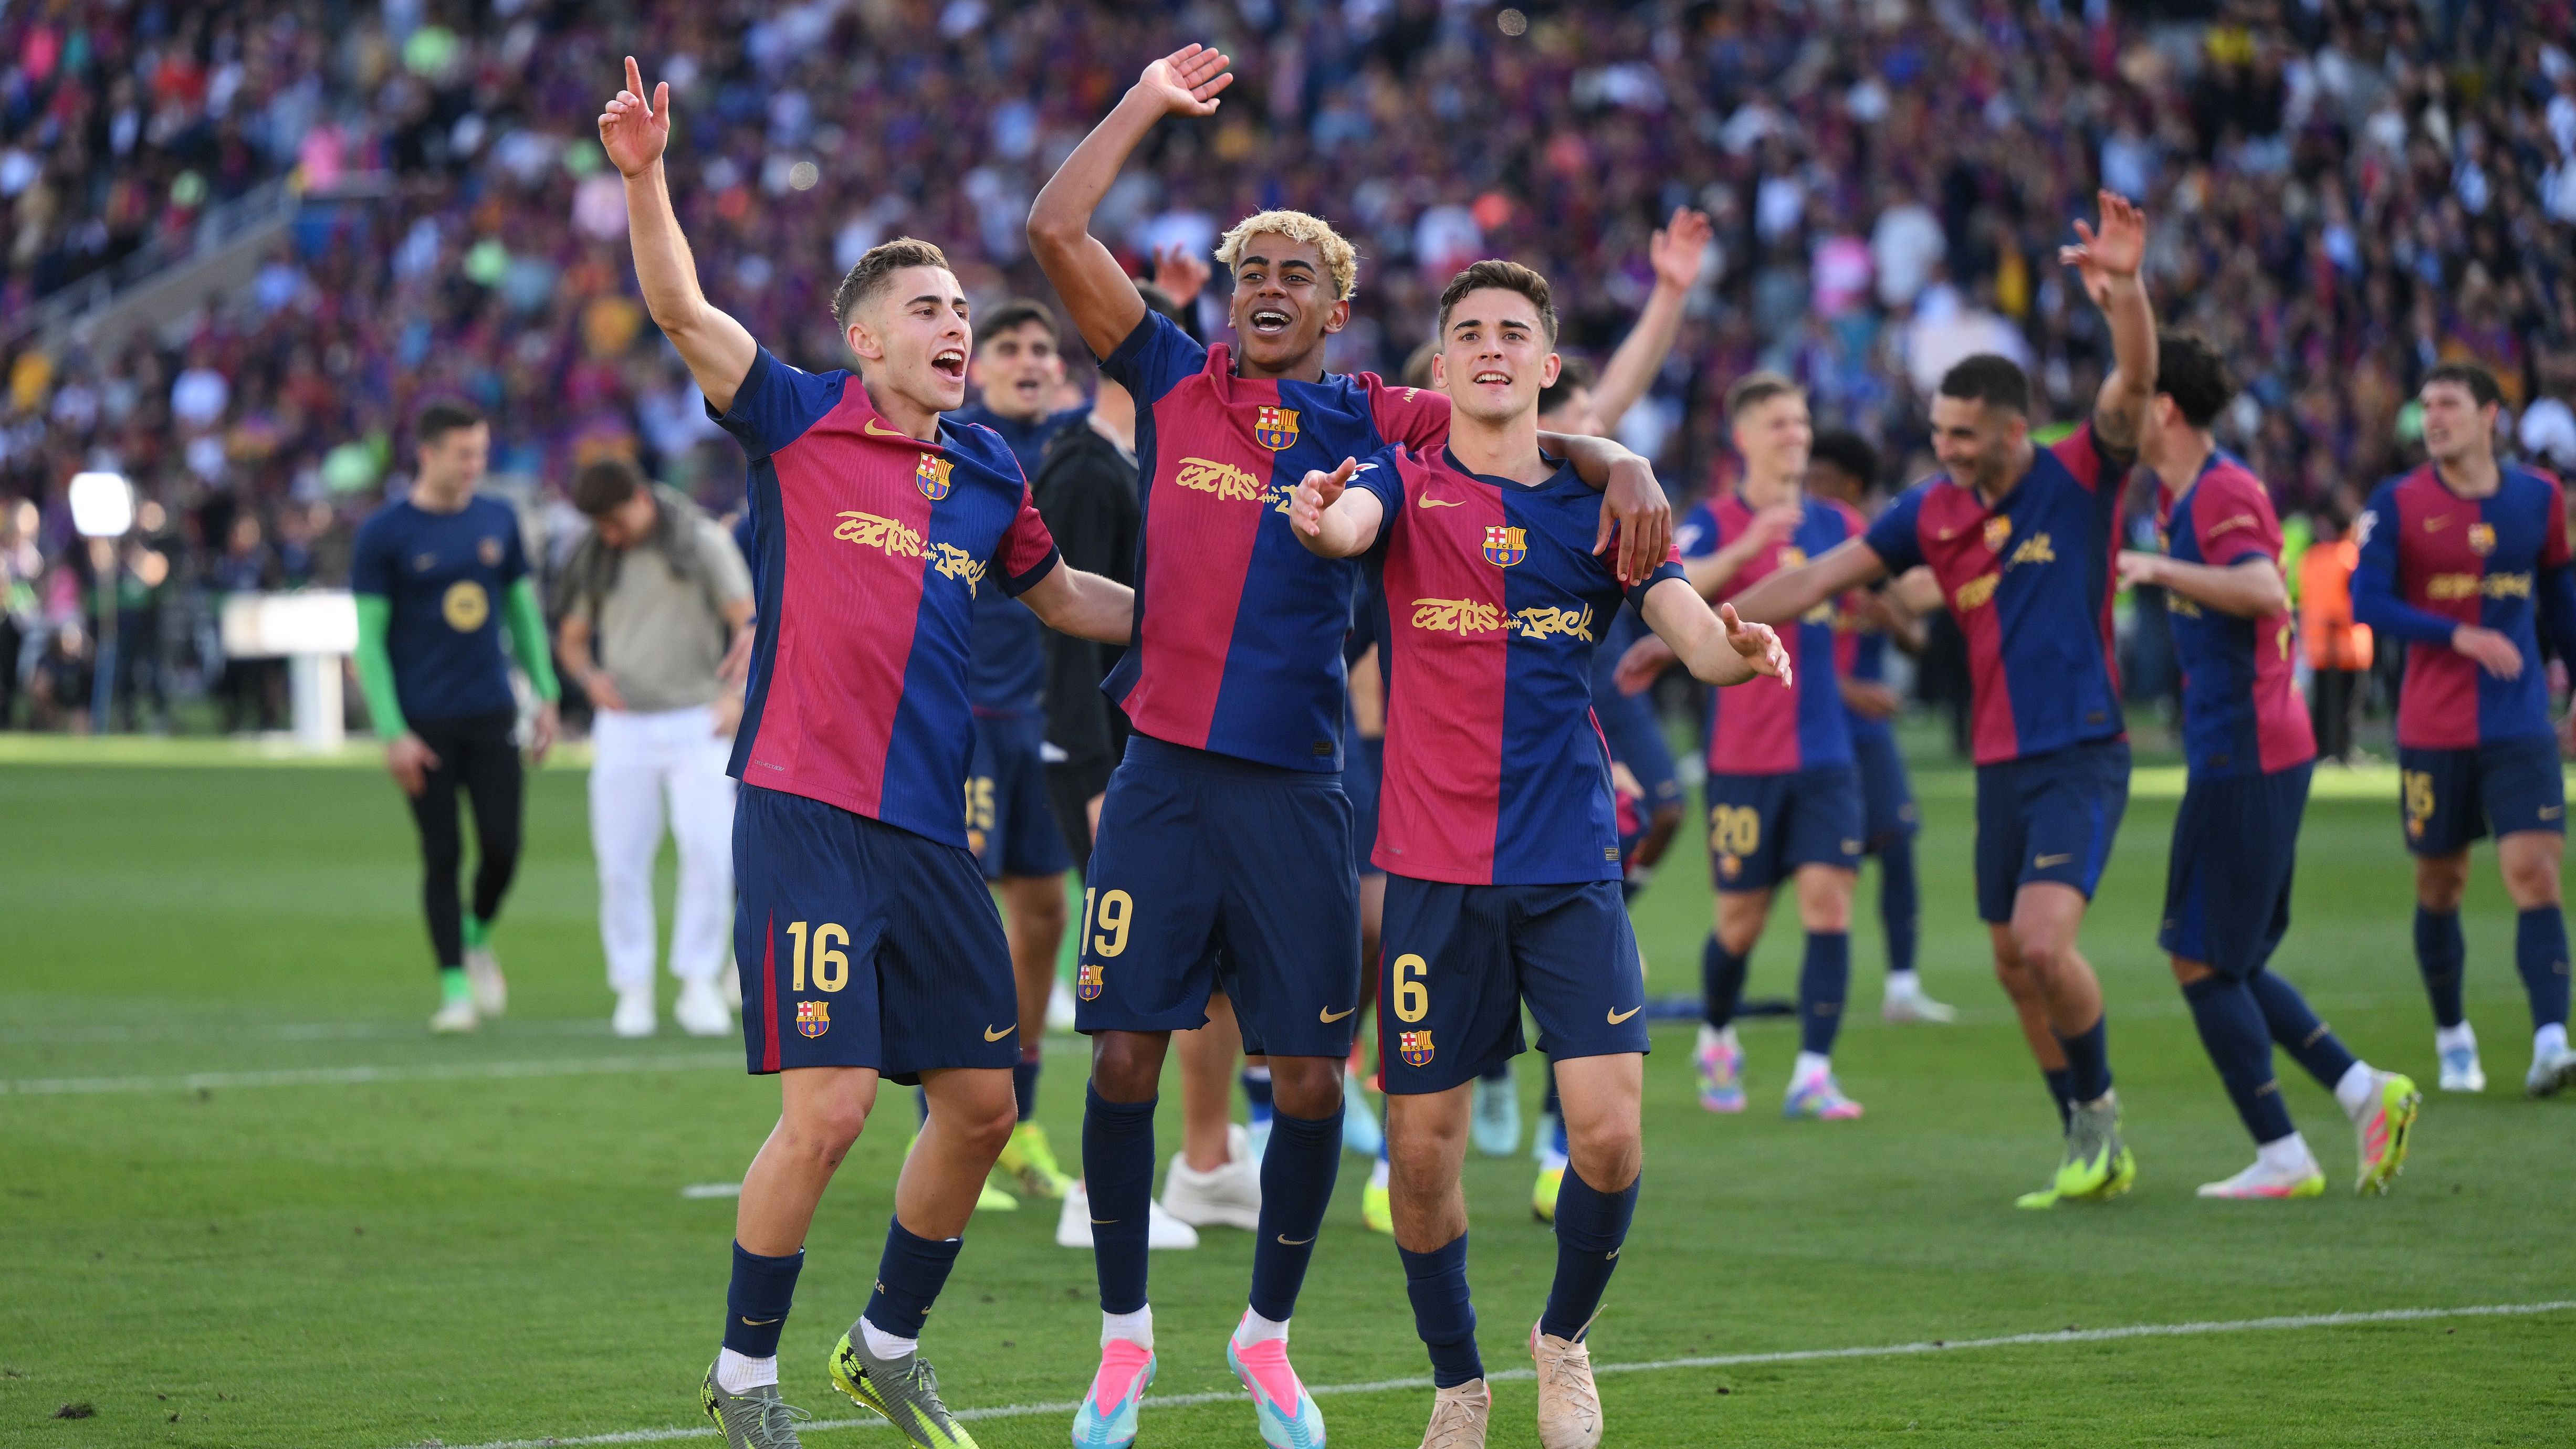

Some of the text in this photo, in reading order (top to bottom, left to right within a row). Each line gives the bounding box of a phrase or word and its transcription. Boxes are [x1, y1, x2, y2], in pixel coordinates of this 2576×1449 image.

[1712, 803, 1761, 857] 20
[786, 921, 850, 992] 16
[1082, 887, 1133, 958] 19
[1393, 953, 1428, 1023] 6
